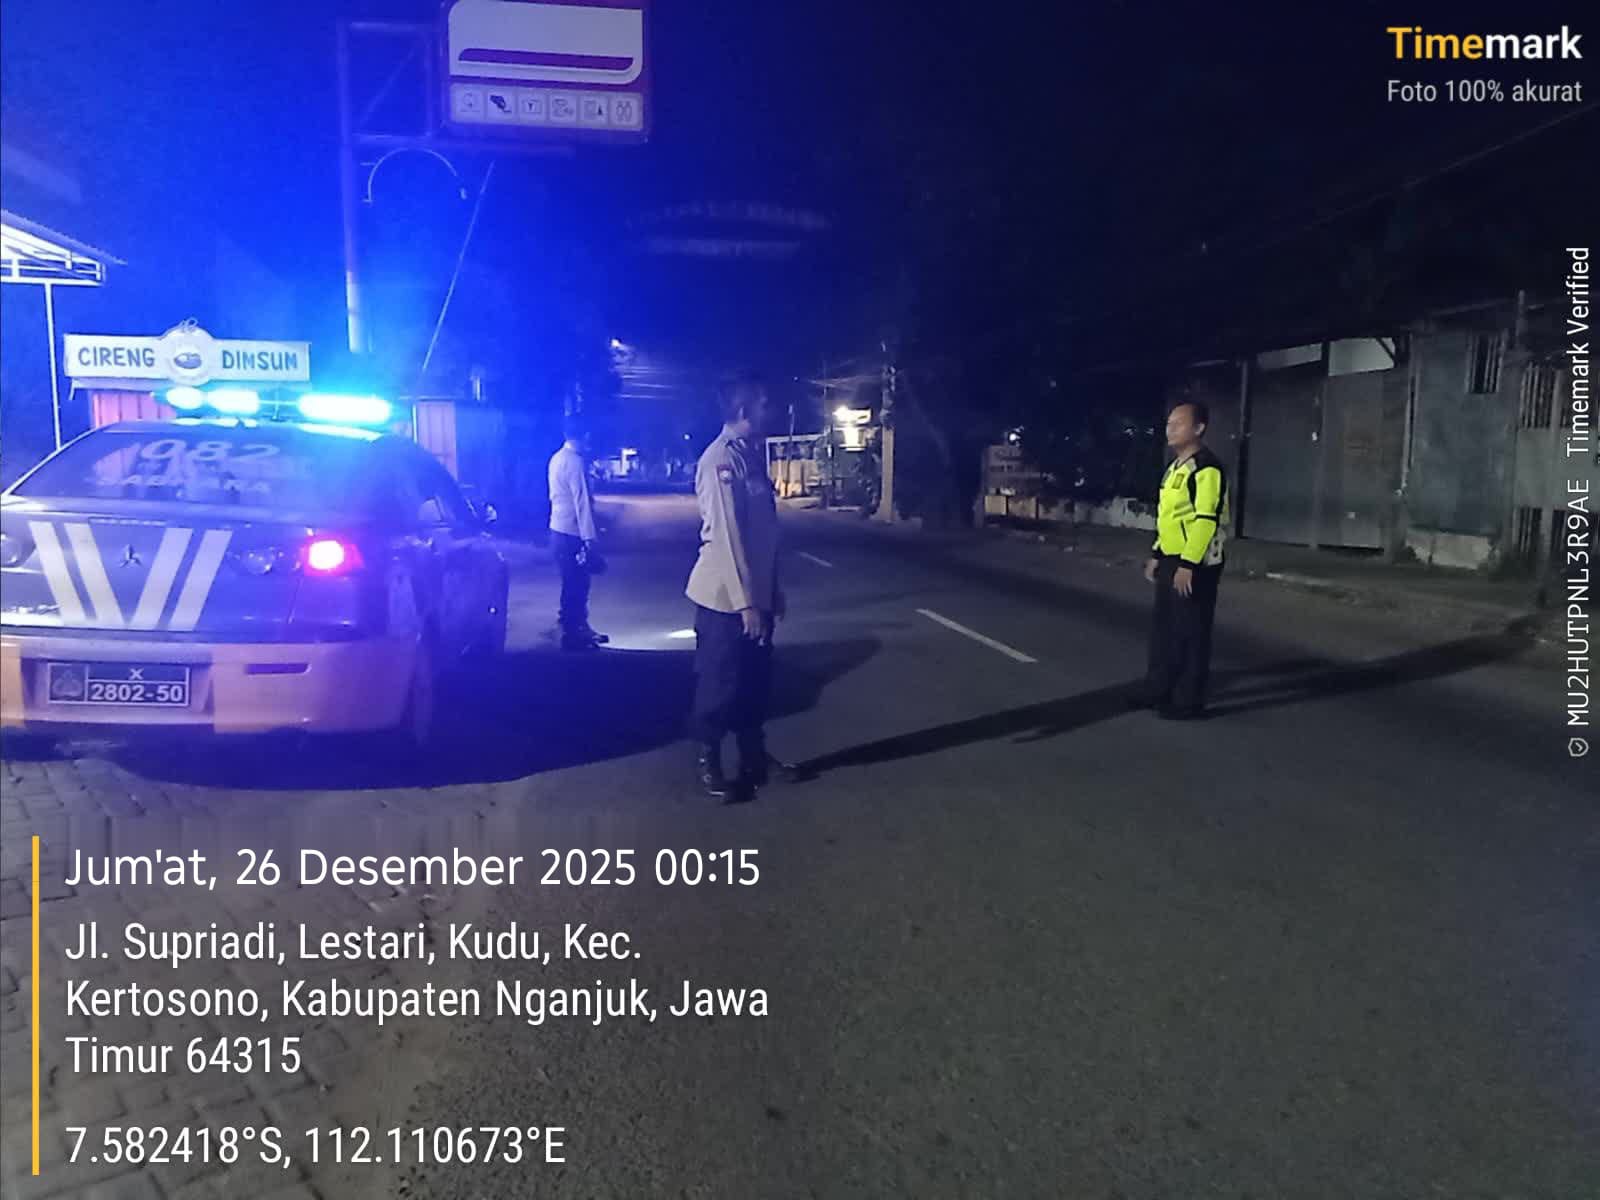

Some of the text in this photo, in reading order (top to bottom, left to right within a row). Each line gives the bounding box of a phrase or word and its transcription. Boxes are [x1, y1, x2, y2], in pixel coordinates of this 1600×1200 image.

[77, 347, 298, 370] CIRENG DIMSUM
[90, 683, 184, 701] 2802-50
